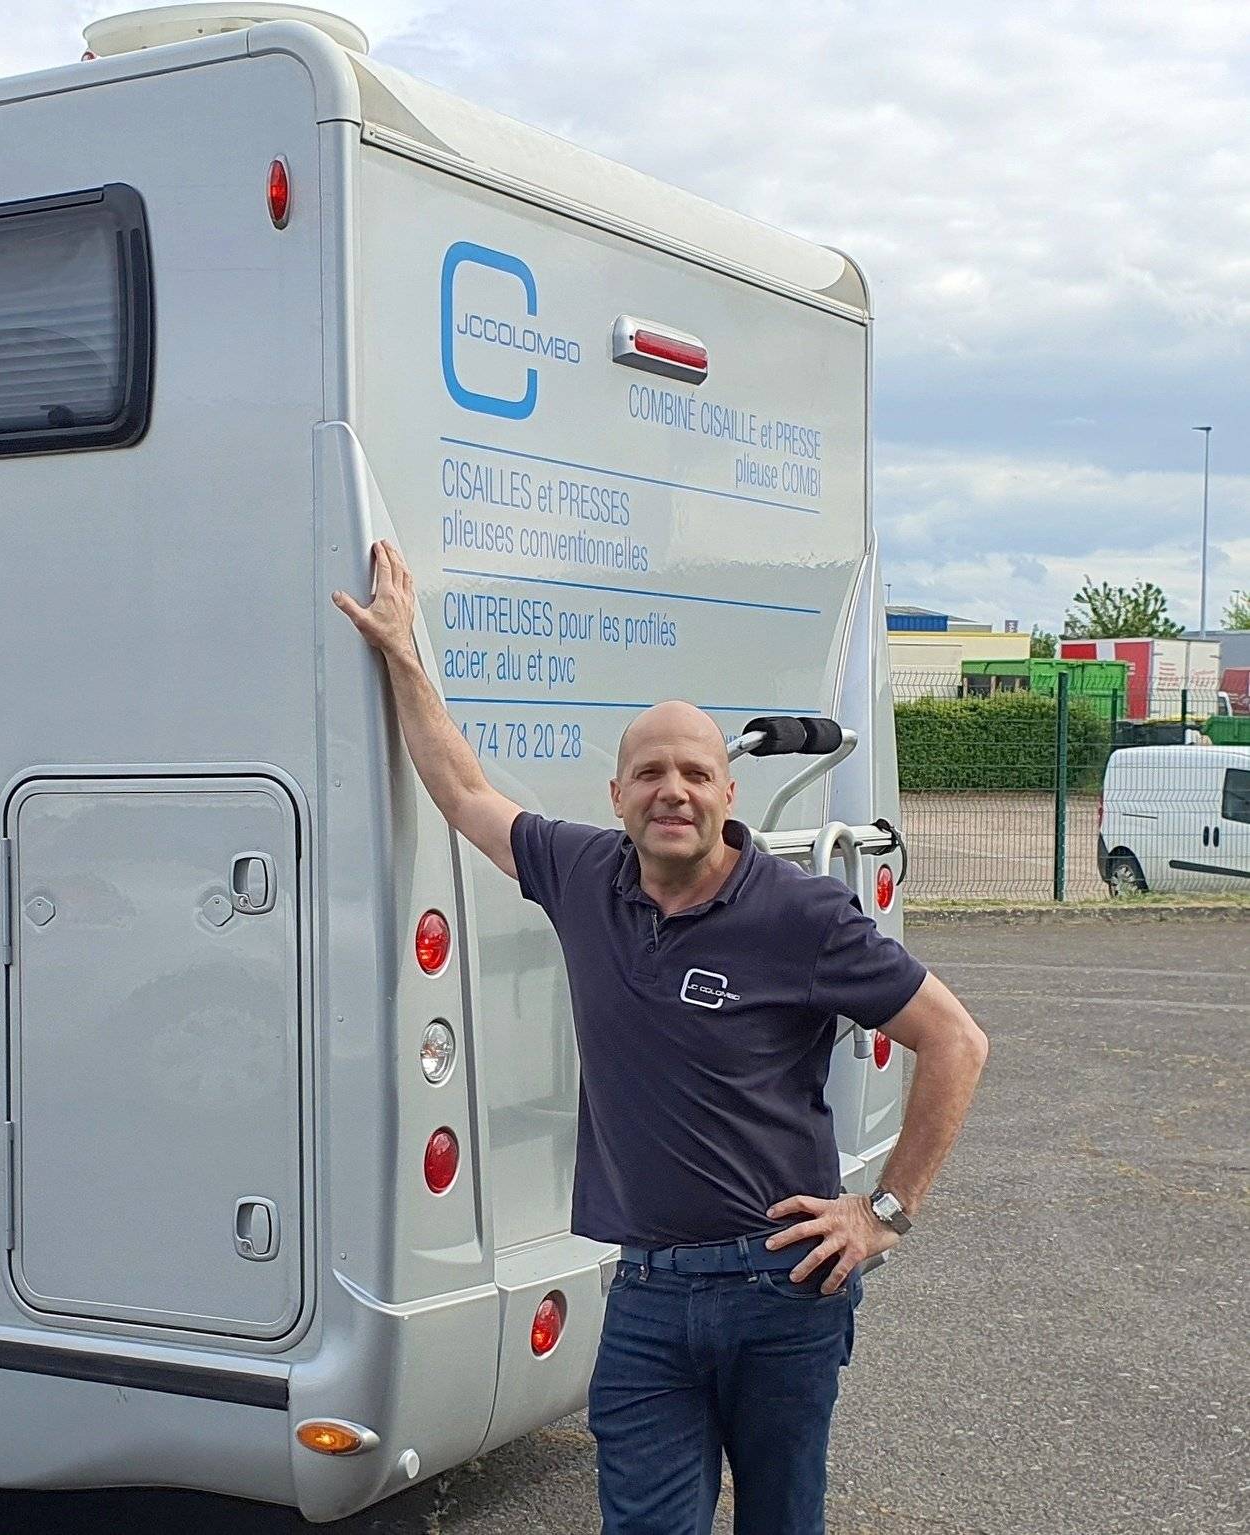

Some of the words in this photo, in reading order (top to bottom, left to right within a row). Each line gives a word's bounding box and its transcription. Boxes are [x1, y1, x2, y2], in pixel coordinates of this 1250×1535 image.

[456, 312, 581, 364] JCCOLOMBO
[628, 383, 696, 432] COMBINÉ
[700, 402, 757, 446] CISAILLE
[760, 420, 773, 450] et
[776, 421, 821, 461] PRESSE
[442, 458, 532, 510] CISAILLES
[537, 480, 554, 513] et
[558, 480, 630, 526] PRESSES
[735, 452, 778, 489] plieuse
[782, 461, 822, 498] COMBI
[443, 509, 514, 553] plieuses
[519, 528, 649, 572] conventionnelles
[443, 591, 553, 638] CINTREUSES
[559, 610, 595, 646] pour
[599, 608, 621, 643] les
[625, 612, 678, 651] profilés
[444, 642, 492, 685] acier,
[496, 645, 522, 682] alu
[526, 648, 544, 683] et
[548, 654, 576, 691] pvc
[475, 722, 499, 759] 74
[505, 722, 528, 759] 78
[533, 722, 555, 759] 20
[560, 723, 582, 759] 28
